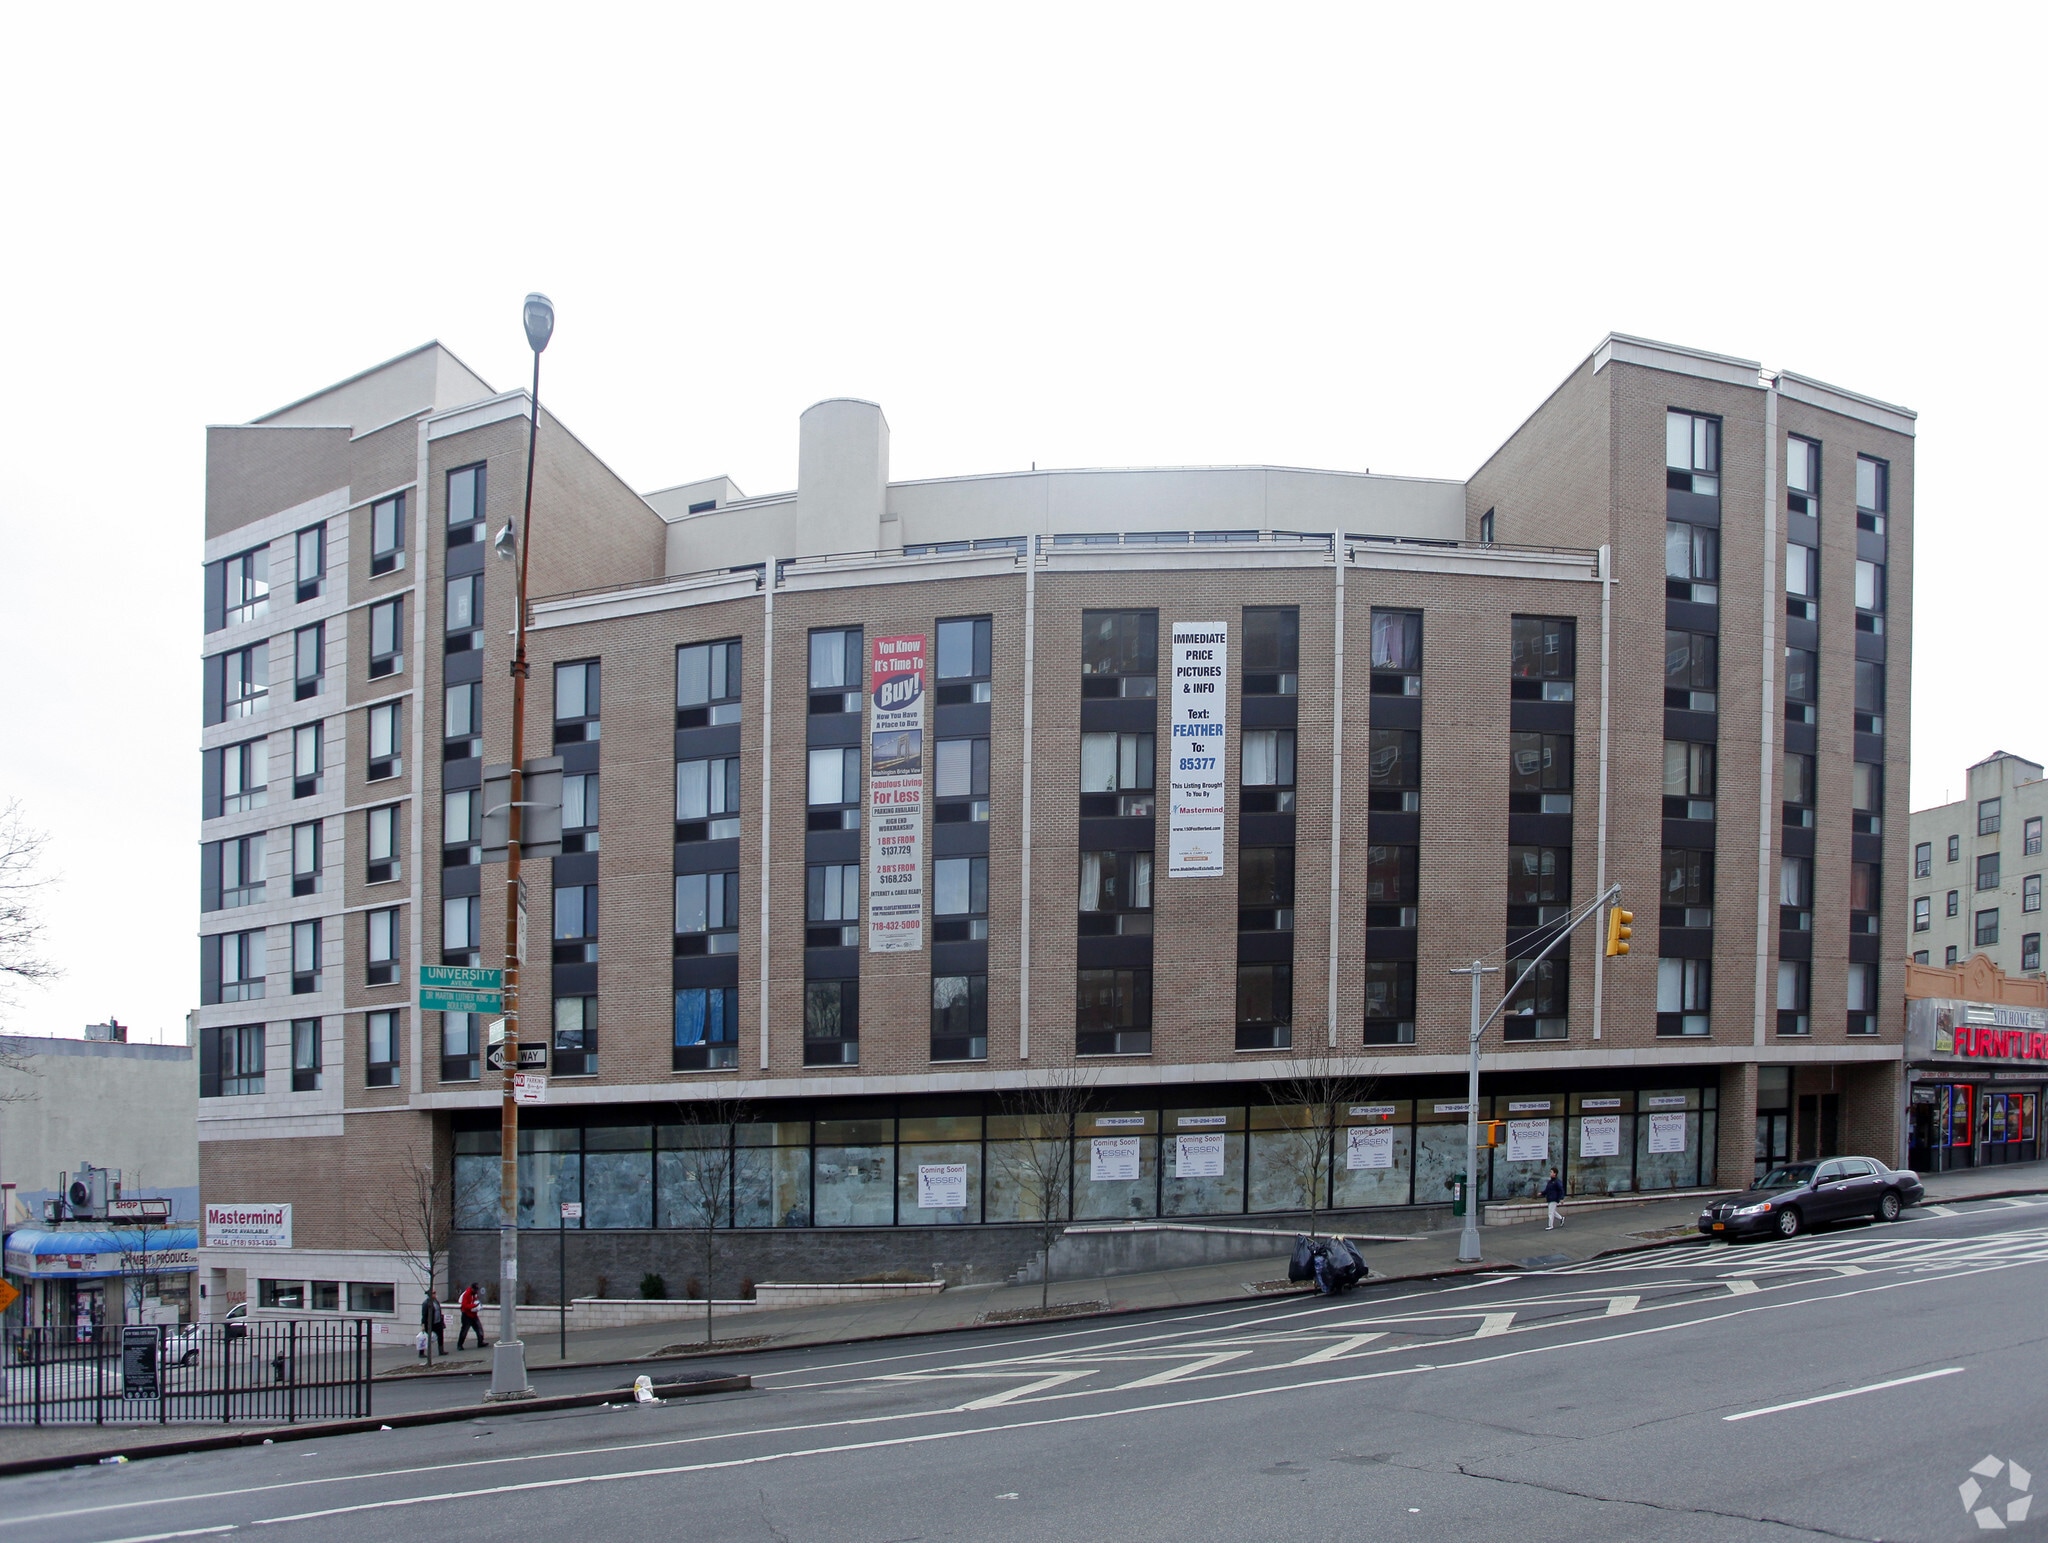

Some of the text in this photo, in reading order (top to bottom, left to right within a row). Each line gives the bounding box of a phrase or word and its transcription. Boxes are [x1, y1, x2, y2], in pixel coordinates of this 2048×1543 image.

[1174, 634, 1225, 644] IMMEDIATE
[879, 640, 920, 654] You Know
[1186, 650, 1213, 660] PRICE
[874, 657, 924, 672] It's Time To
[1177, 666, 1221, 677] PICTURES
[881, 672, 920, 707] Buy!
[1183, 683, 1214, 693] & INFO
[1188, 709, 1209, 719] Text:
[1173, 724, 1223, 737] FEATHER
[1192, 742, 1205, 752] To:
[1179, 758, 1216, 770] 85377
[871, 779, 922, 789] Fabulous Living
[873, 790, 920, 804] For Less
[897, 835, 915, 844] FROM
[881, 845, 911, 856] $137,729
[898, 864, 915, 872] FROM
[880, 874, 912, 884] $168,253
[872, 920, 920, 930] 718-432-5000
[428, 967, 495, 981] UNIVERSITY
[426, 991, 496, 1003] DR MARTIN LUTHER KING JR
[447, 1002, 477, 1010] BOULEVARD
[2009, 1011, 2030, 1026] HOME
[494, 1051, 538, 1063] ON WAY
[516, 1076, 525, 1085] NO
[1350, 1128, 1372, 1136] Coming
[1094, 1139, 1118, 1147] Coming
[1179, 1136, 1203, 1144] Coming
[209, 1209, 283, 1224] Mastermind
[133, 1254, 152, 1265] MEAT
[156, 1252, 189, 1264] PRODUCE
